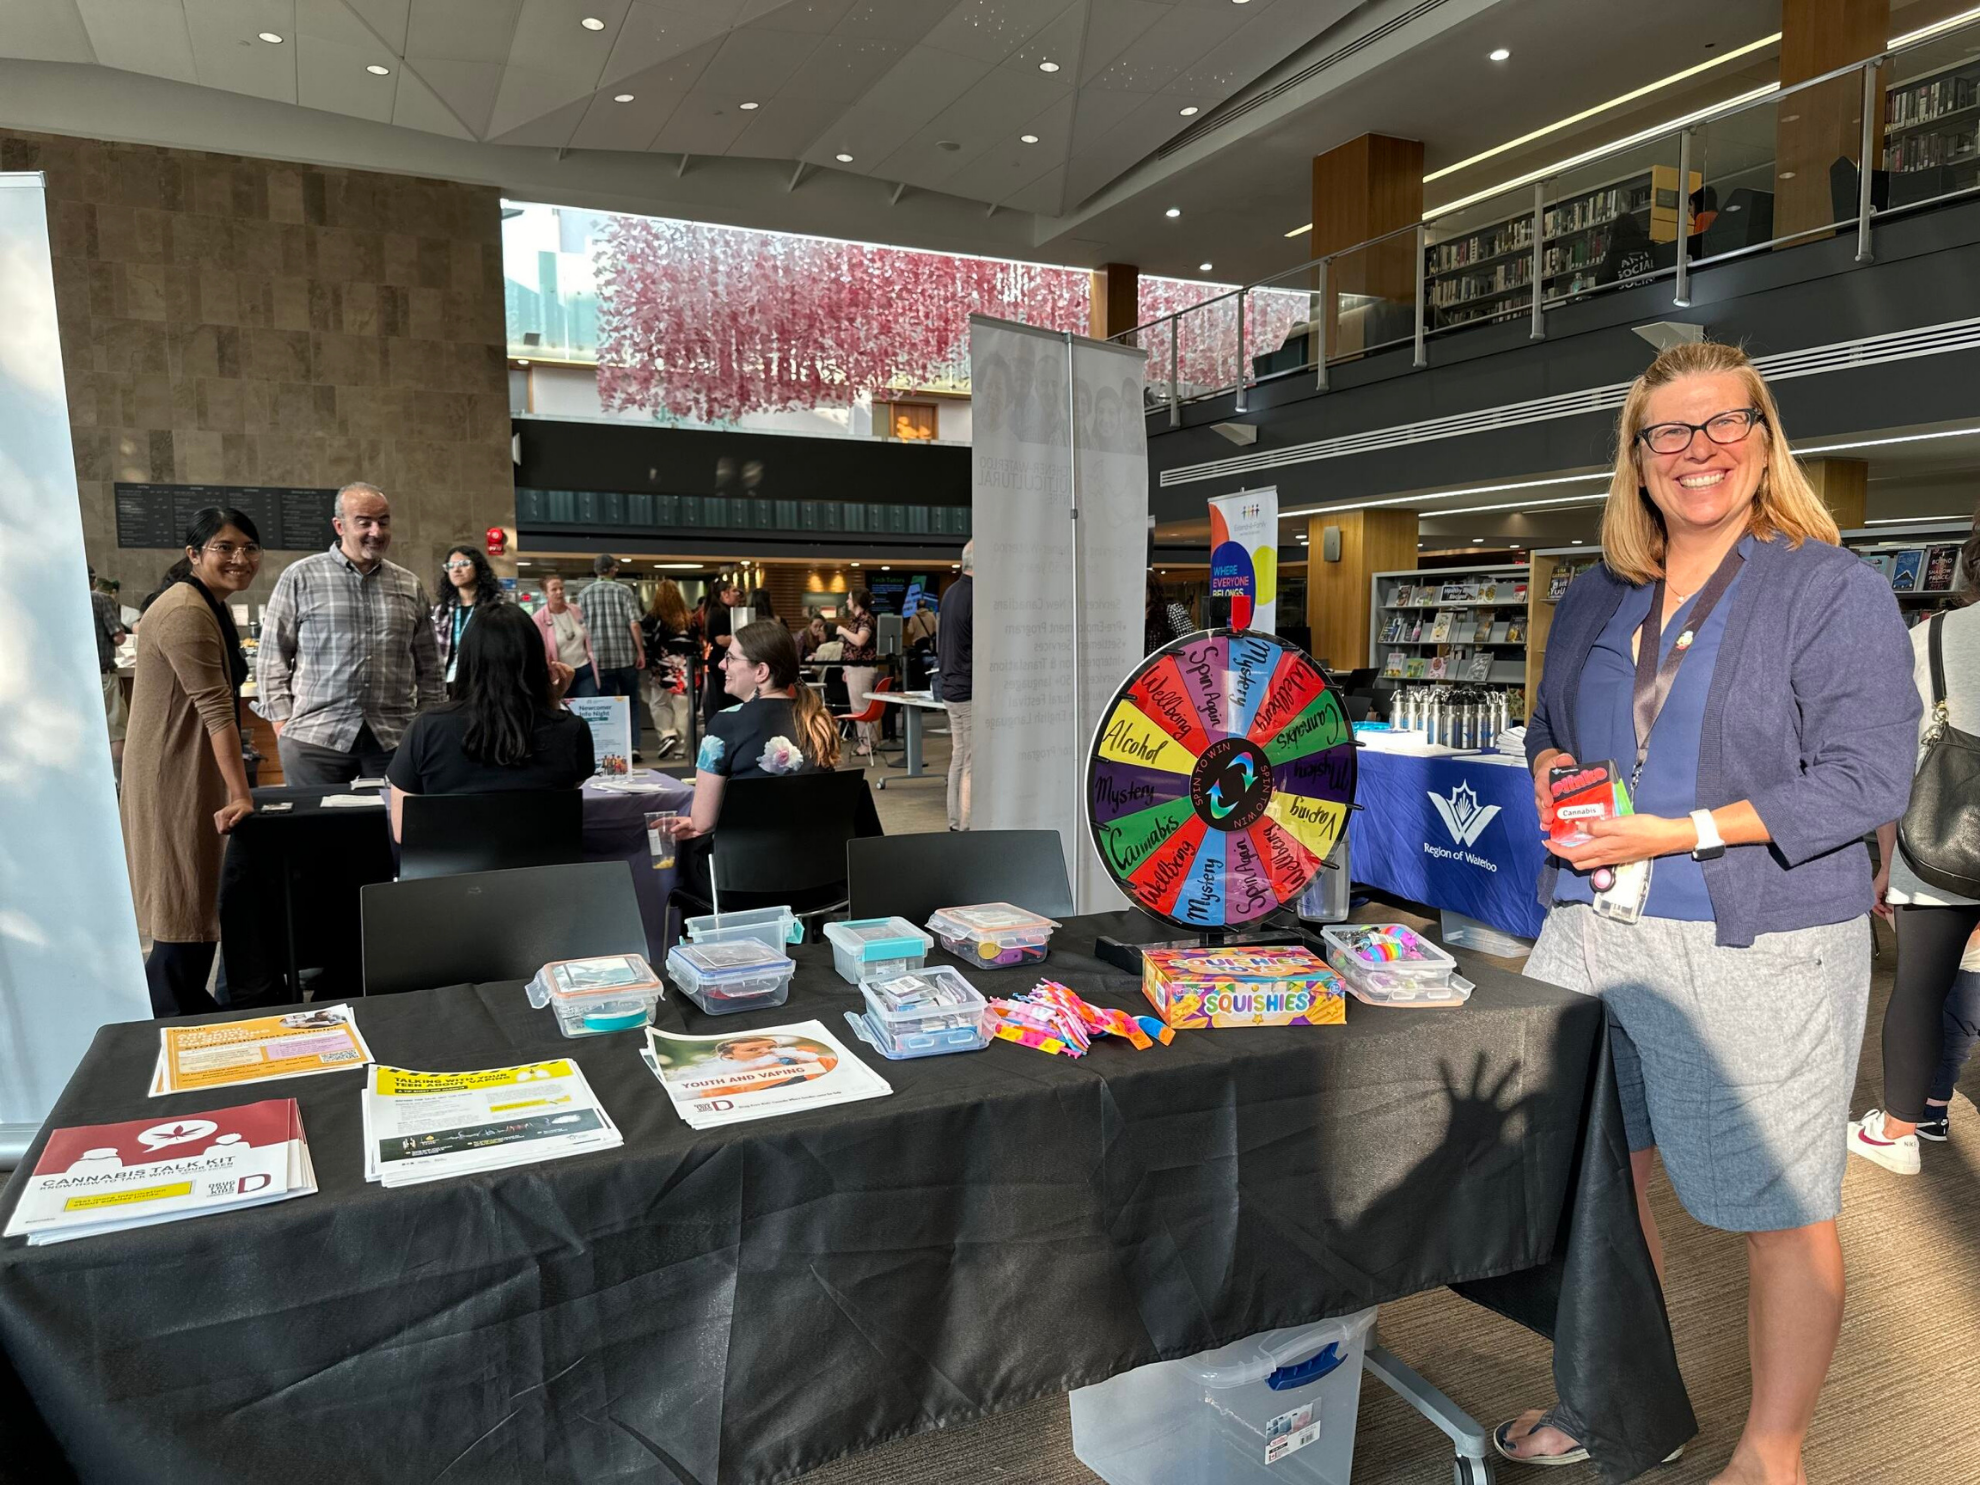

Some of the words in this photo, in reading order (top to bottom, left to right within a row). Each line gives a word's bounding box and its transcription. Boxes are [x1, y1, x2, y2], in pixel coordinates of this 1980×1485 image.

[1212, 576, 1249, 588] EVERYONE
[1213, 565, 1238, 576] WHERE
[1189, 646, 1220, 693] Spin
[1229, 639, 1270, 708] Mystery
[1141, 665, 1192, 740] Wellbeing
[1203, 692, 1222, 728] Again
[1277, 702, 1340, 749] Cannabis
[1102, 720, 1168, 765] Alcohol
[1197, 758, 1208, 775] TO
[1207, 741, 1231, 760] WIN
[1096, 776, 1155, 814] Mystery
[1260, 766, 1269, 794] SPIN
[1233, 812, 1257, 829] WIN
[1290, 795, 1338, 840] Vaping
[1562, 806, 1597, 817] Cannabis
[1110, 815, 1180, 871] Cannabis
[1424, 842, 1452, 859] Region
[1453, 851, 1463, 860] of
[1465, 852, 1498, 872] Waterloo
[1140, 839, 1196, 905] Wellbeing
[1187, 857, 1223, 921] Mystery
[1170, 957, 1311, 967] SQUISHIES
[1212, 965, 1284, 973] TOYS
[1205, 993, 1310, 1014] SQUISHIES
[469, 1075, 510, 1083] VAPING
[680, 1079, 725, 1088] YOUTH
[729, 1074, 755, 1083] AND
[758, 1067, 805, 1079] VAPING
[42, 1169, 146, 1186] CANNABIS
[150, 1160, 199, 1174] TALK
[206, 1156, 236, 1166] KIT
[149, 1169, 175, 1177] WITH
[178, 1164, 206, 1173] YOUR
[208, 1161, 235, 1169] TEEN
